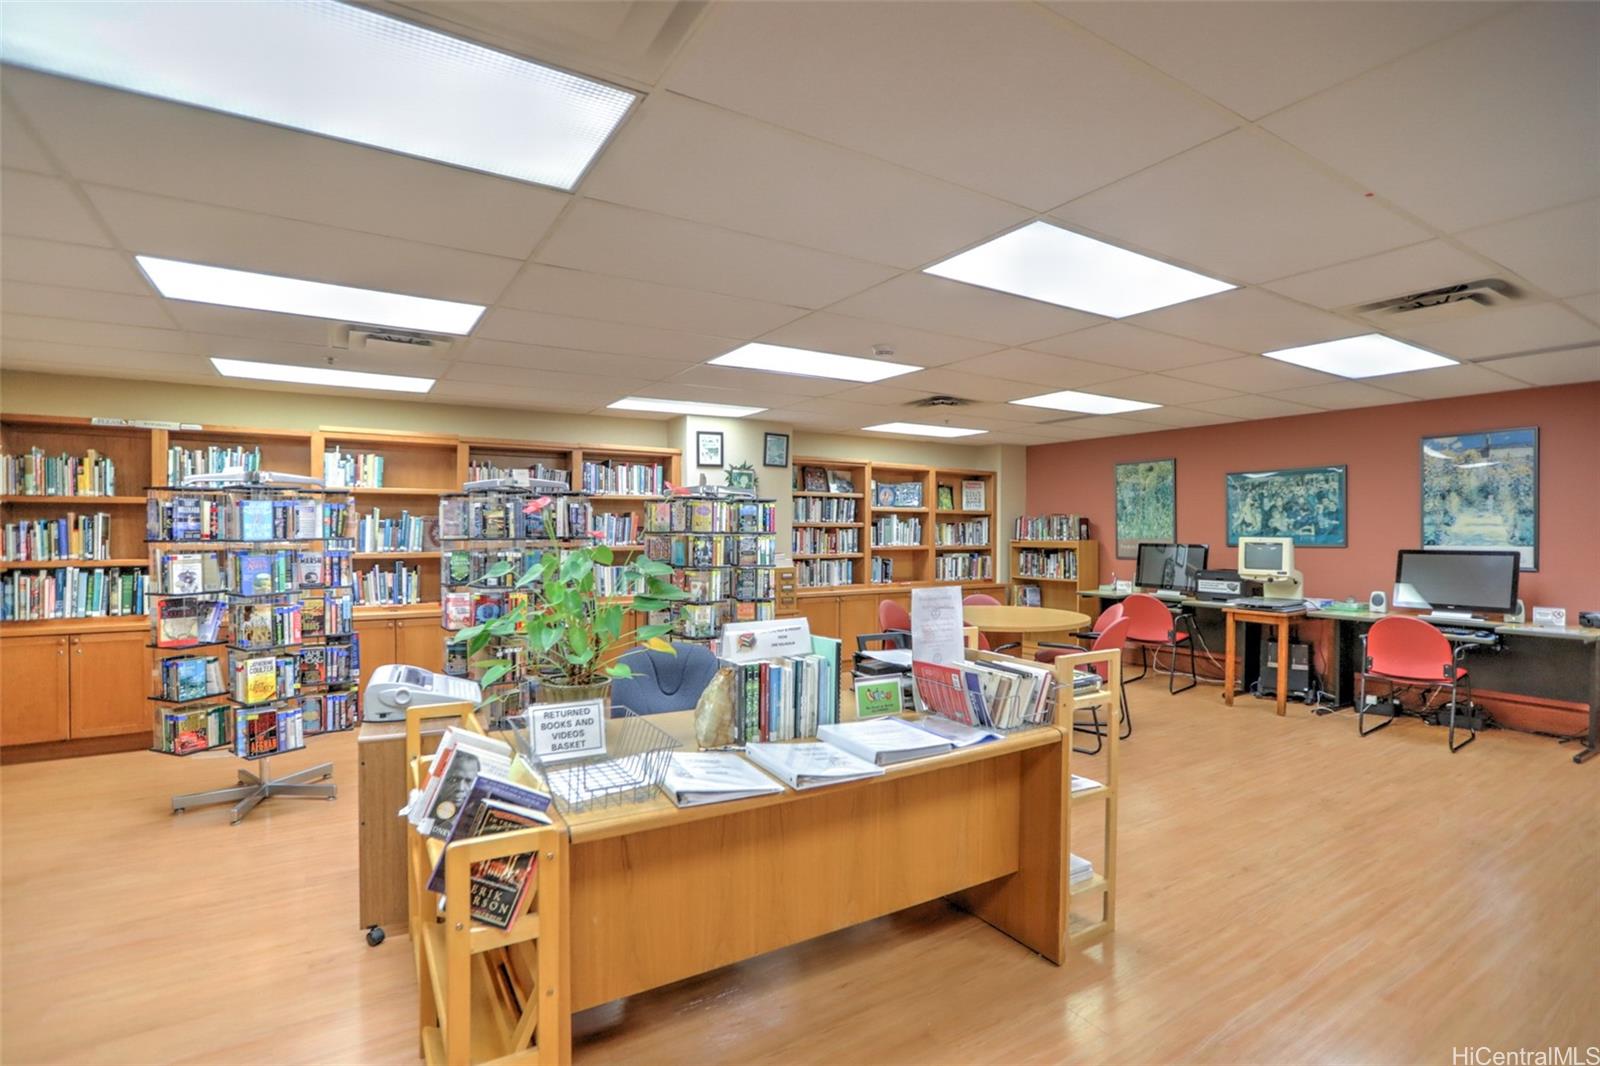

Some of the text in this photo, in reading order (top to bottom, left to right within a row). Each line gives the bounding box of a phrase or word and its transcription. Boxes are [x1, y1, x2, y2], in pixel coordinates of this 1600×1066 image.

[543, 707, 591, 720] RETURNED
[540, 718, 595, 731] BOOKS AND
[551, 729, 585, 740] VIDEOS
[551, 740, 586, 752] BASKET
[472, 895, 509, 914] RSON
